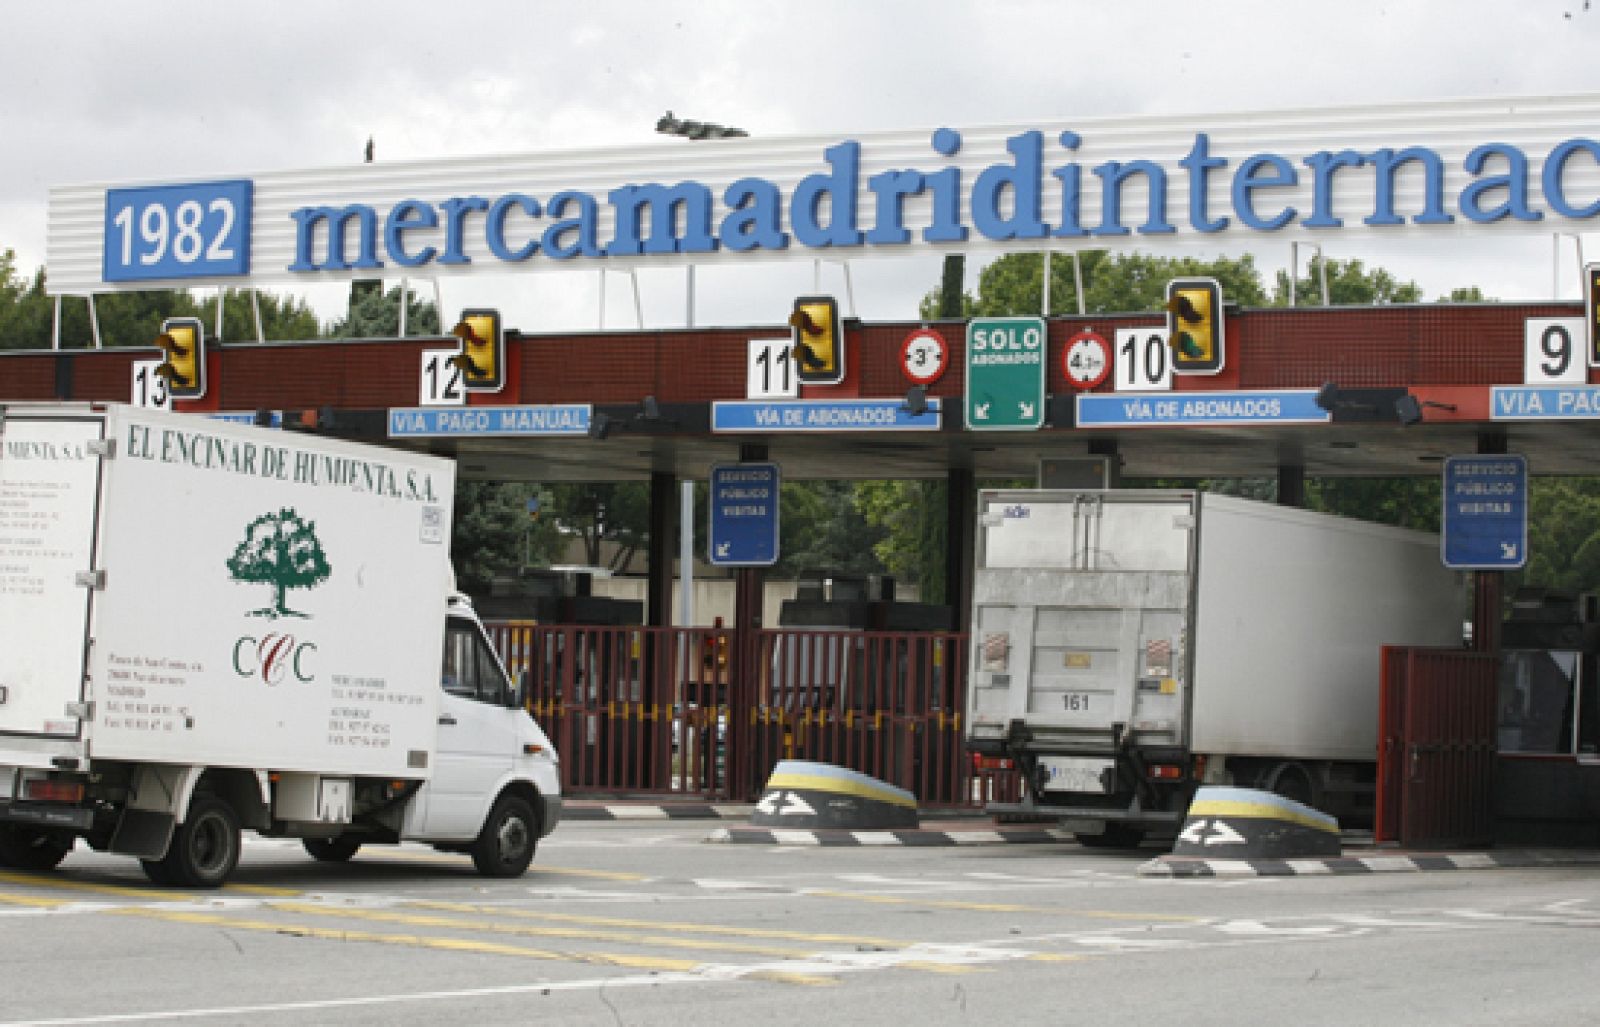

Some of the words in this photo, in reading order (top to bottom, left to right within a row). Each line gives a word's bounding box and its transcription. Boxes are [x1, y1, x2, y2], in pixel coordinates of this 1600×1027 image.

[114, 198, 236, 266] 1982
[972, 328, 1040, 350] SOLO
[1541, 323, 1571, 378] 9
[755, 345, 790, 393] 11
[1120, 334, 1165, 384] 10
[425, 354, 463, 400] 12
[394, 411, 427, 432] VIA
[436, 410, 490, 431] PAGO
[502, 407, 588, 429] MANUAL
[783, 408, 804, 425] DE
[808, 406, 896, 425] ABONADOS
[1155, 400, 1179, 417] DE
[1183, 398, 1280, 417] ABONADOS
[1500, 391, 1543, 414] VIA
[127, 424, 154, 459] EL
[161, 430, 257, 475] ENCINAR
[261, 445, 288, 481] DE
[1062, 695, 1089, 711] 161
